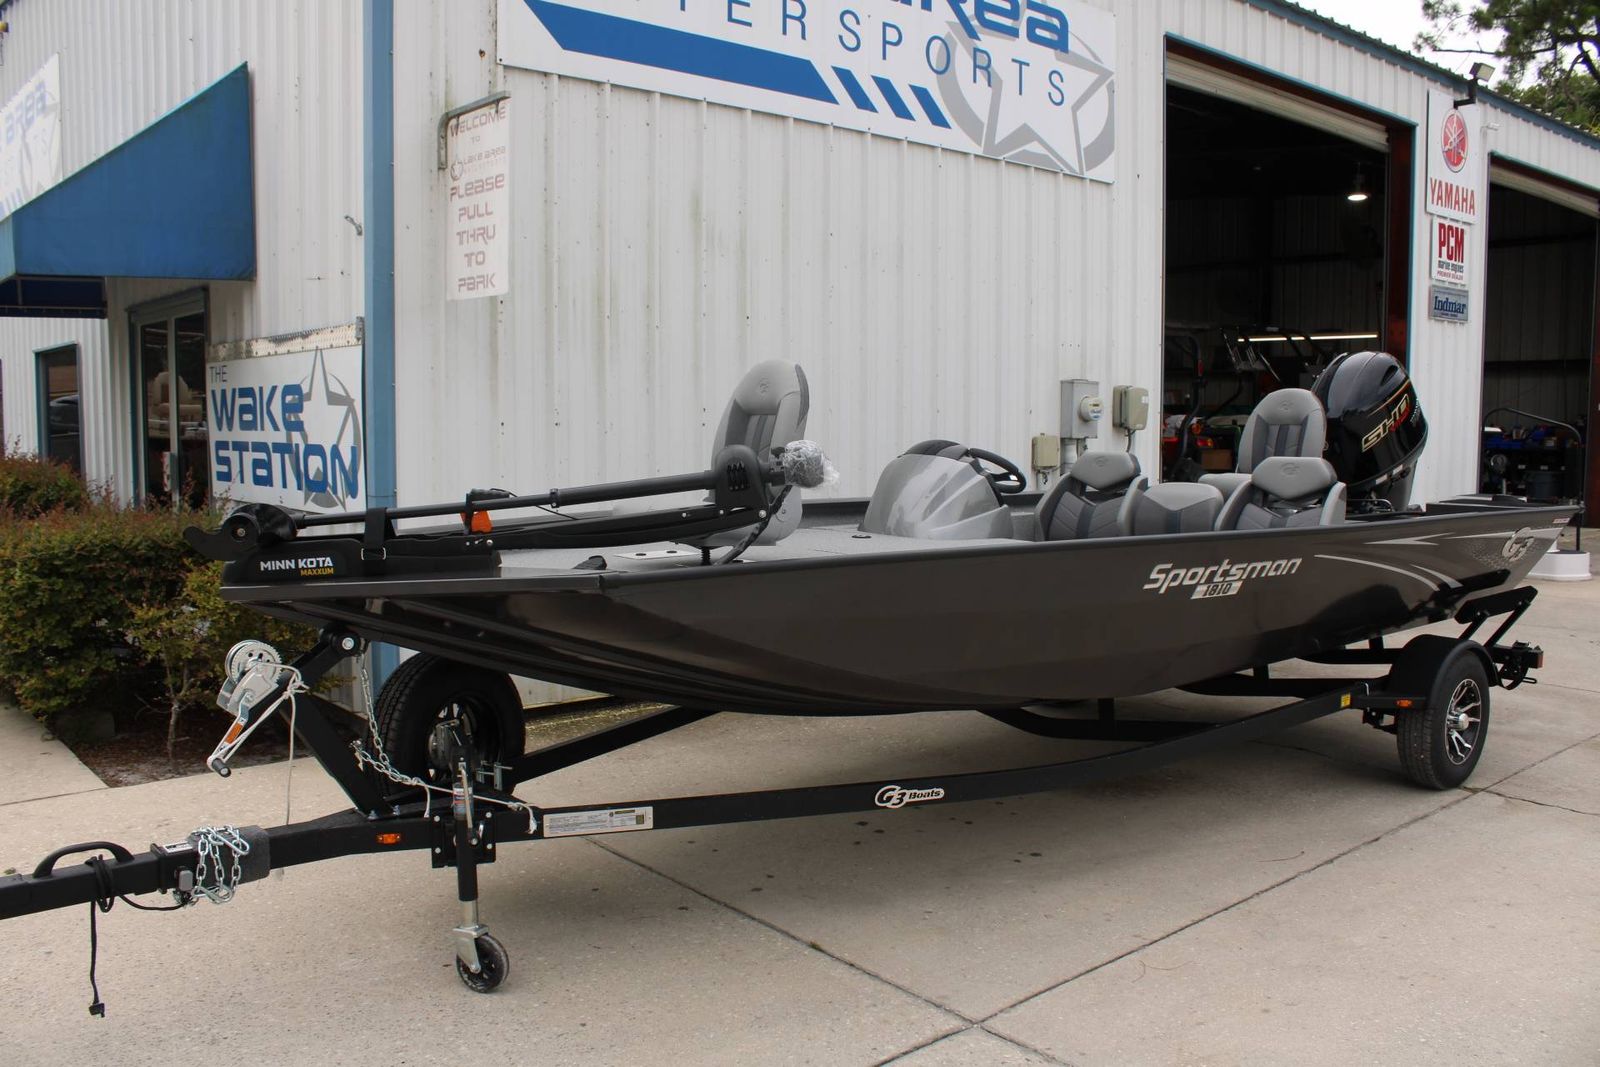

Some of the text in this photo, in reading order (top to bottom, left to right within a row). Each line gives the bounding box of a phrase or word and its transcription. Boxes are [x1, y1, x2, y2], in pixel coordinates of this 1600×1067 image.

[679, 0, 1067, 107] ERSPORTS
[450, 105, 506, 137] WELCOME
[1429, 176, 1476, 217] YAMAHA
[458, 201, 493, 222] PULL
[456, 223, 496, 246] THRU
[1438, 222, 1465, 264] PCM
[464, 250, 486, 268] TO
[1434, 294, 1467, 315] Indmar
[209, 365, 228, 383] THE
[260, 556, 334, 572] MINN KOTA
[300, 567, 334, 577] MAXXUM
[1143, 558, 1303, 594] Sportsman
[1202, 582, 1233, 597] 1810
[875, 785, 941, 808] G3 Boats
